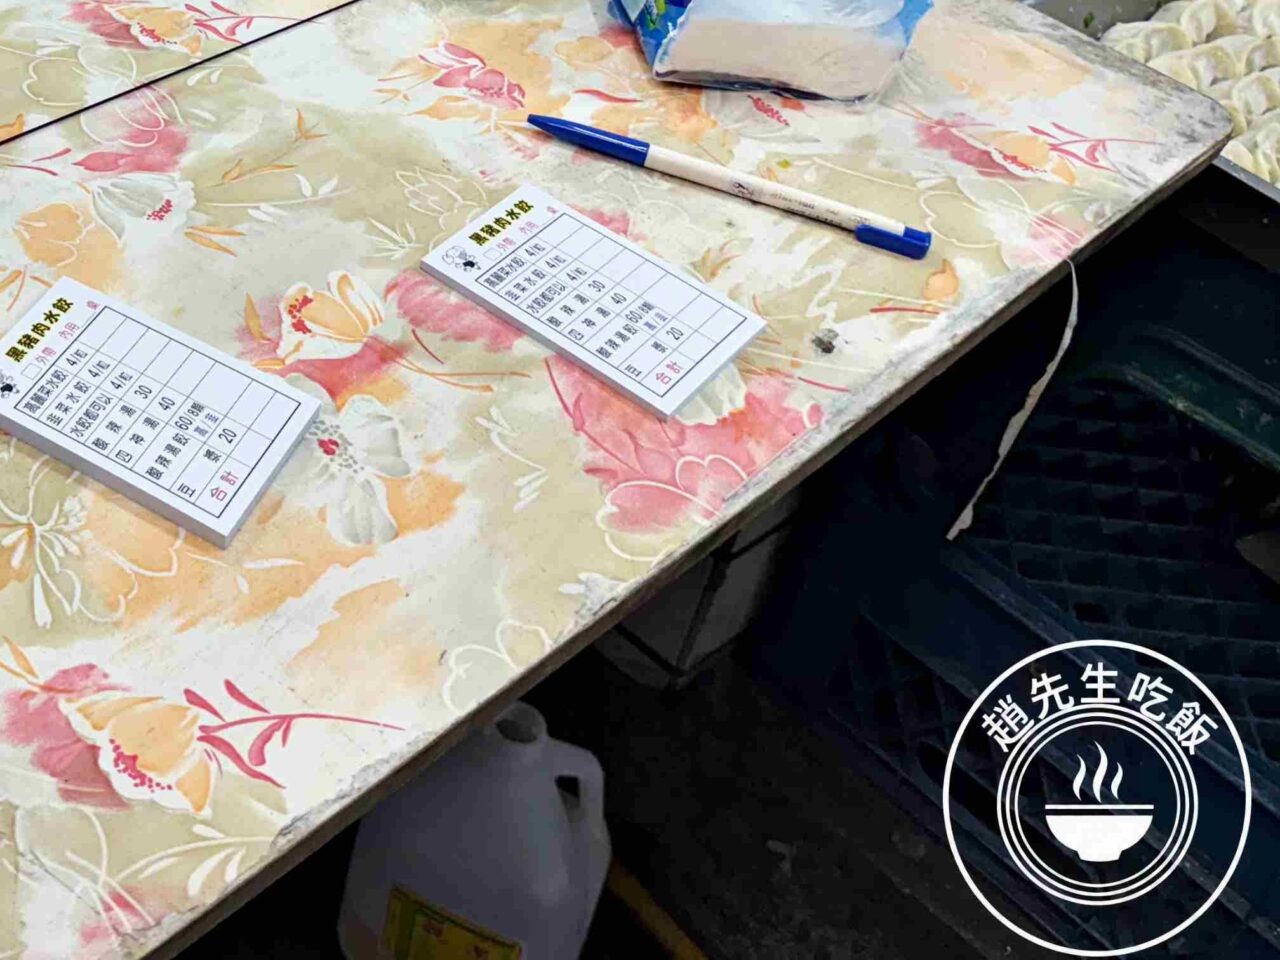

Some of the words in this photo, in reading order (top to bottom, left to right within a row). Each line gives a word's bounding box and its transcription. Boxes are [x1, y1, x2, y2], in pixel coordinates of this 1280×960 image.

[469, 200, 534, 246] 黑豬肉水餃
[483, 257, 527, 290] 高麗菜水餃
[524, 244, 546, 256] 4/粒
[501, 269, 547, 303] 韭菜水餃
[545, 255, 566, 268] 4/粒
[526, 281, 568, 313] 水餃都可以
[566, 267, 587, 281] 4/粒
[588, 280, 605, 292] 30
[611, 293, 627, 304] 40
[5, 298, 73, 362] 黑豬肉水餃
[35, 347, 56, 366] 外帶
[58, 322, 82, 340] 內用
[666, 327, 684, 340] 20
[21, 370, 69, 416] 高麗菜水餃
[66, 349, 88, 366] 4/粒
[47, 381, 91, 426] 韭菜水餃
[88, 361, 110, 377] 4/粒
[656, 361, 684, 385] 合計
[70, 393, 113, 437] 水餃都可以
[110, 372, 133, 389] 4/粒
[91, 405, 136, 451] 酸辣湯
[134, 385, 152, 399] 30
[115, 417, 159, 463] 四神湯
[158, 397, 175, 410] 40
[145, 433, 190, 480] 酸辣湯餃
[170, 399, 206, 432] 60/8顆
[218, 429, 237, 444] 20
[211, 471, 238, 501] 合計
